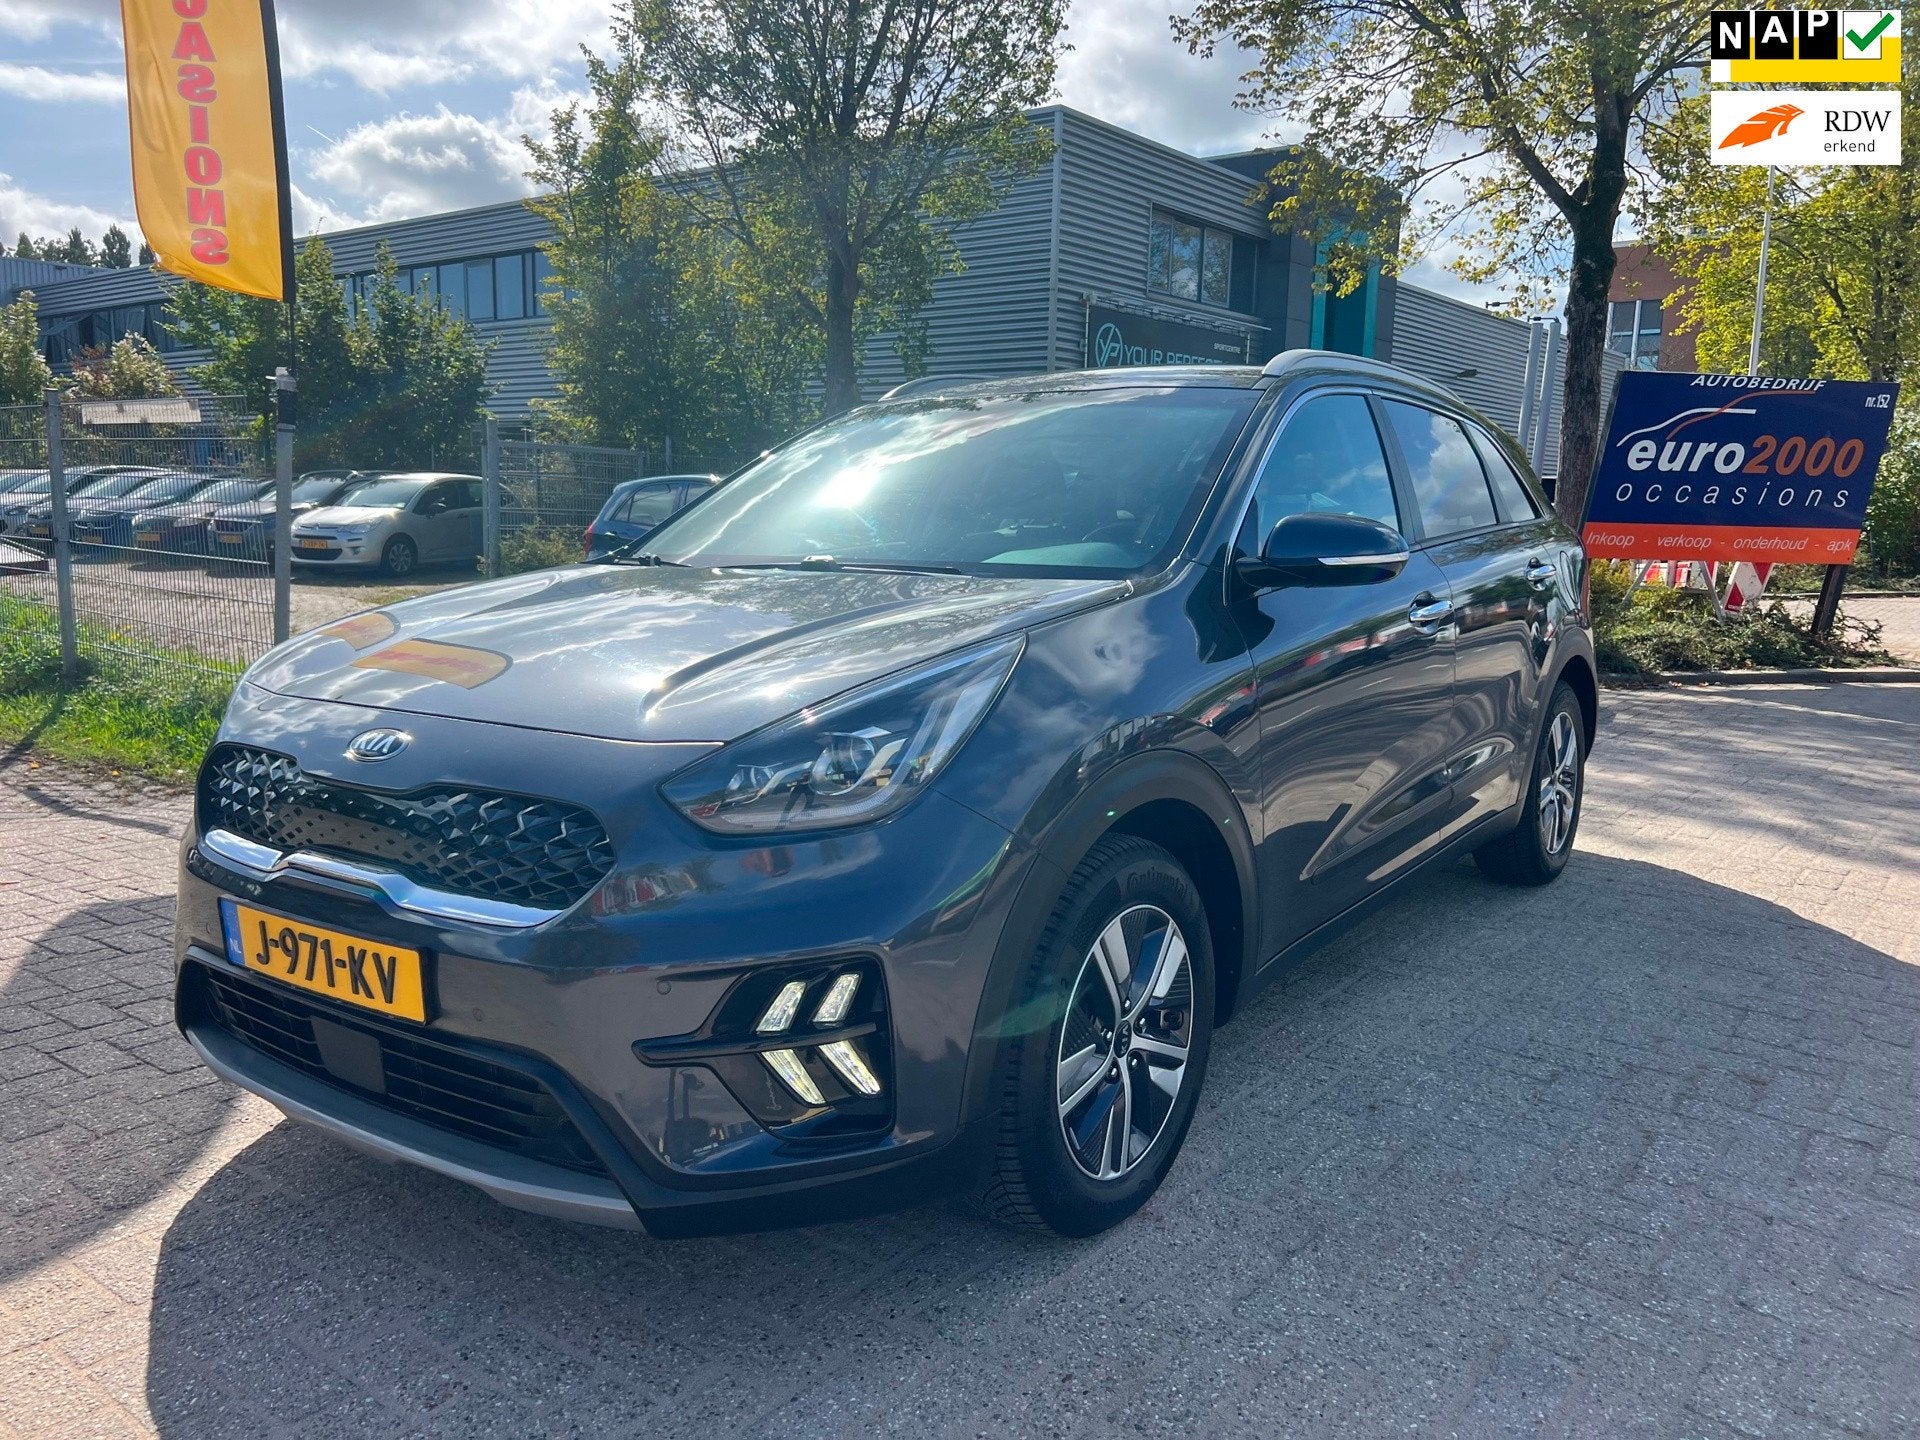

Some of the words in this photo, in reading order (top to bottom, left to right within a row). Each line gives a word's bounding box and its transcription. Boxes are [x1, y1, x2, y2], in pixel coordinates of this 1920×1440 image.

[1124, 345, 1162, 365] YOUR
[1690, 375, 1827, 391] AUTOBEDRIJF
[1865, 394, 1890, 408] nr.152
[1627, 435, 1865, 478] euro2000
[1615, 482, 1849, 507] occasions
[1586, 531, 1635, 547] Inkoop
[1657, 534, 1712, 550] verkoop
[1733, 536, 1808, 550] onderhoud
[1826, 540, 1852, 553] apk
[353, 732, 396, 754] KIA
[256, 920, 397, 1004] J-971-KV
